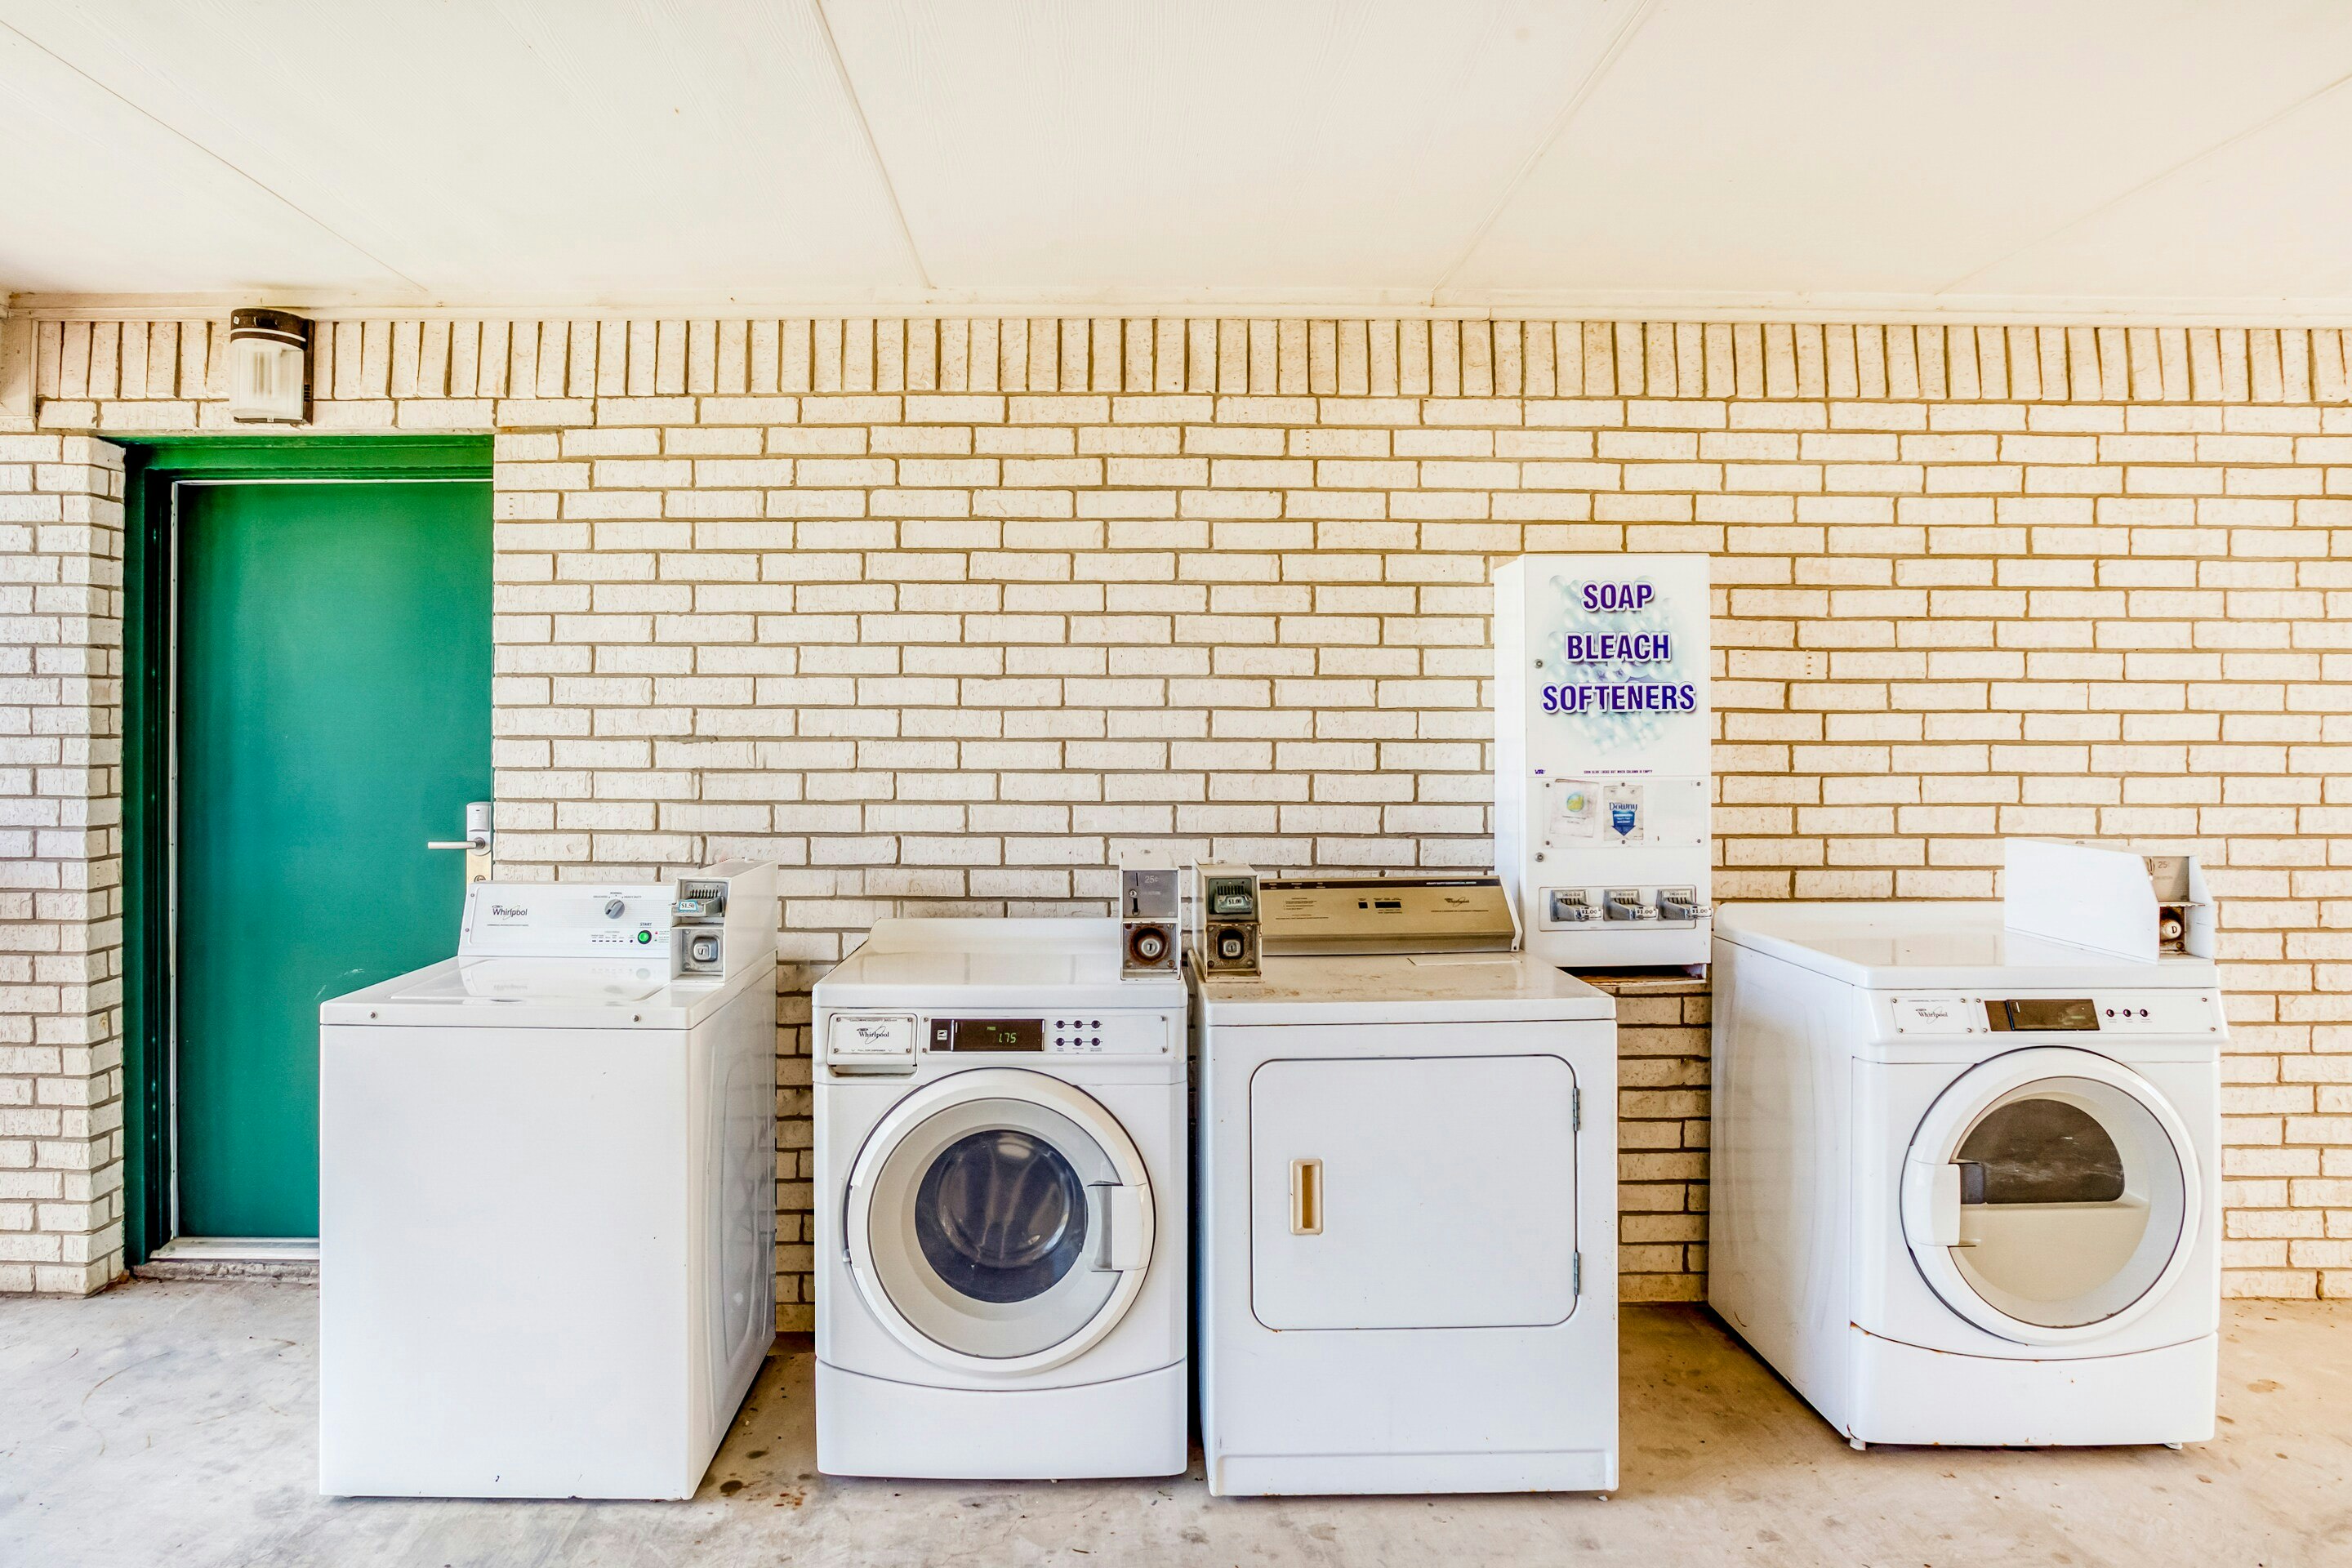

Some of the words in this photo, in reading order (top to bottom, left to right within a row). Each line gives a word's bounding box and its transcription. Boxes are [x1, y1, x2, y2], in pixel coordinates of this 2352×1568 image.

[1583, 583, 1653, 609] SOAP
[1567, 634, 1670, 660] BLEACH
[1543, 684, 1695, 711] SOFTENERS
[1609, 802, 1638, 811] Downy
[492, 908, 528, 917] Whirlpool
[858, 1031, 889, 1039] Whirlpool
